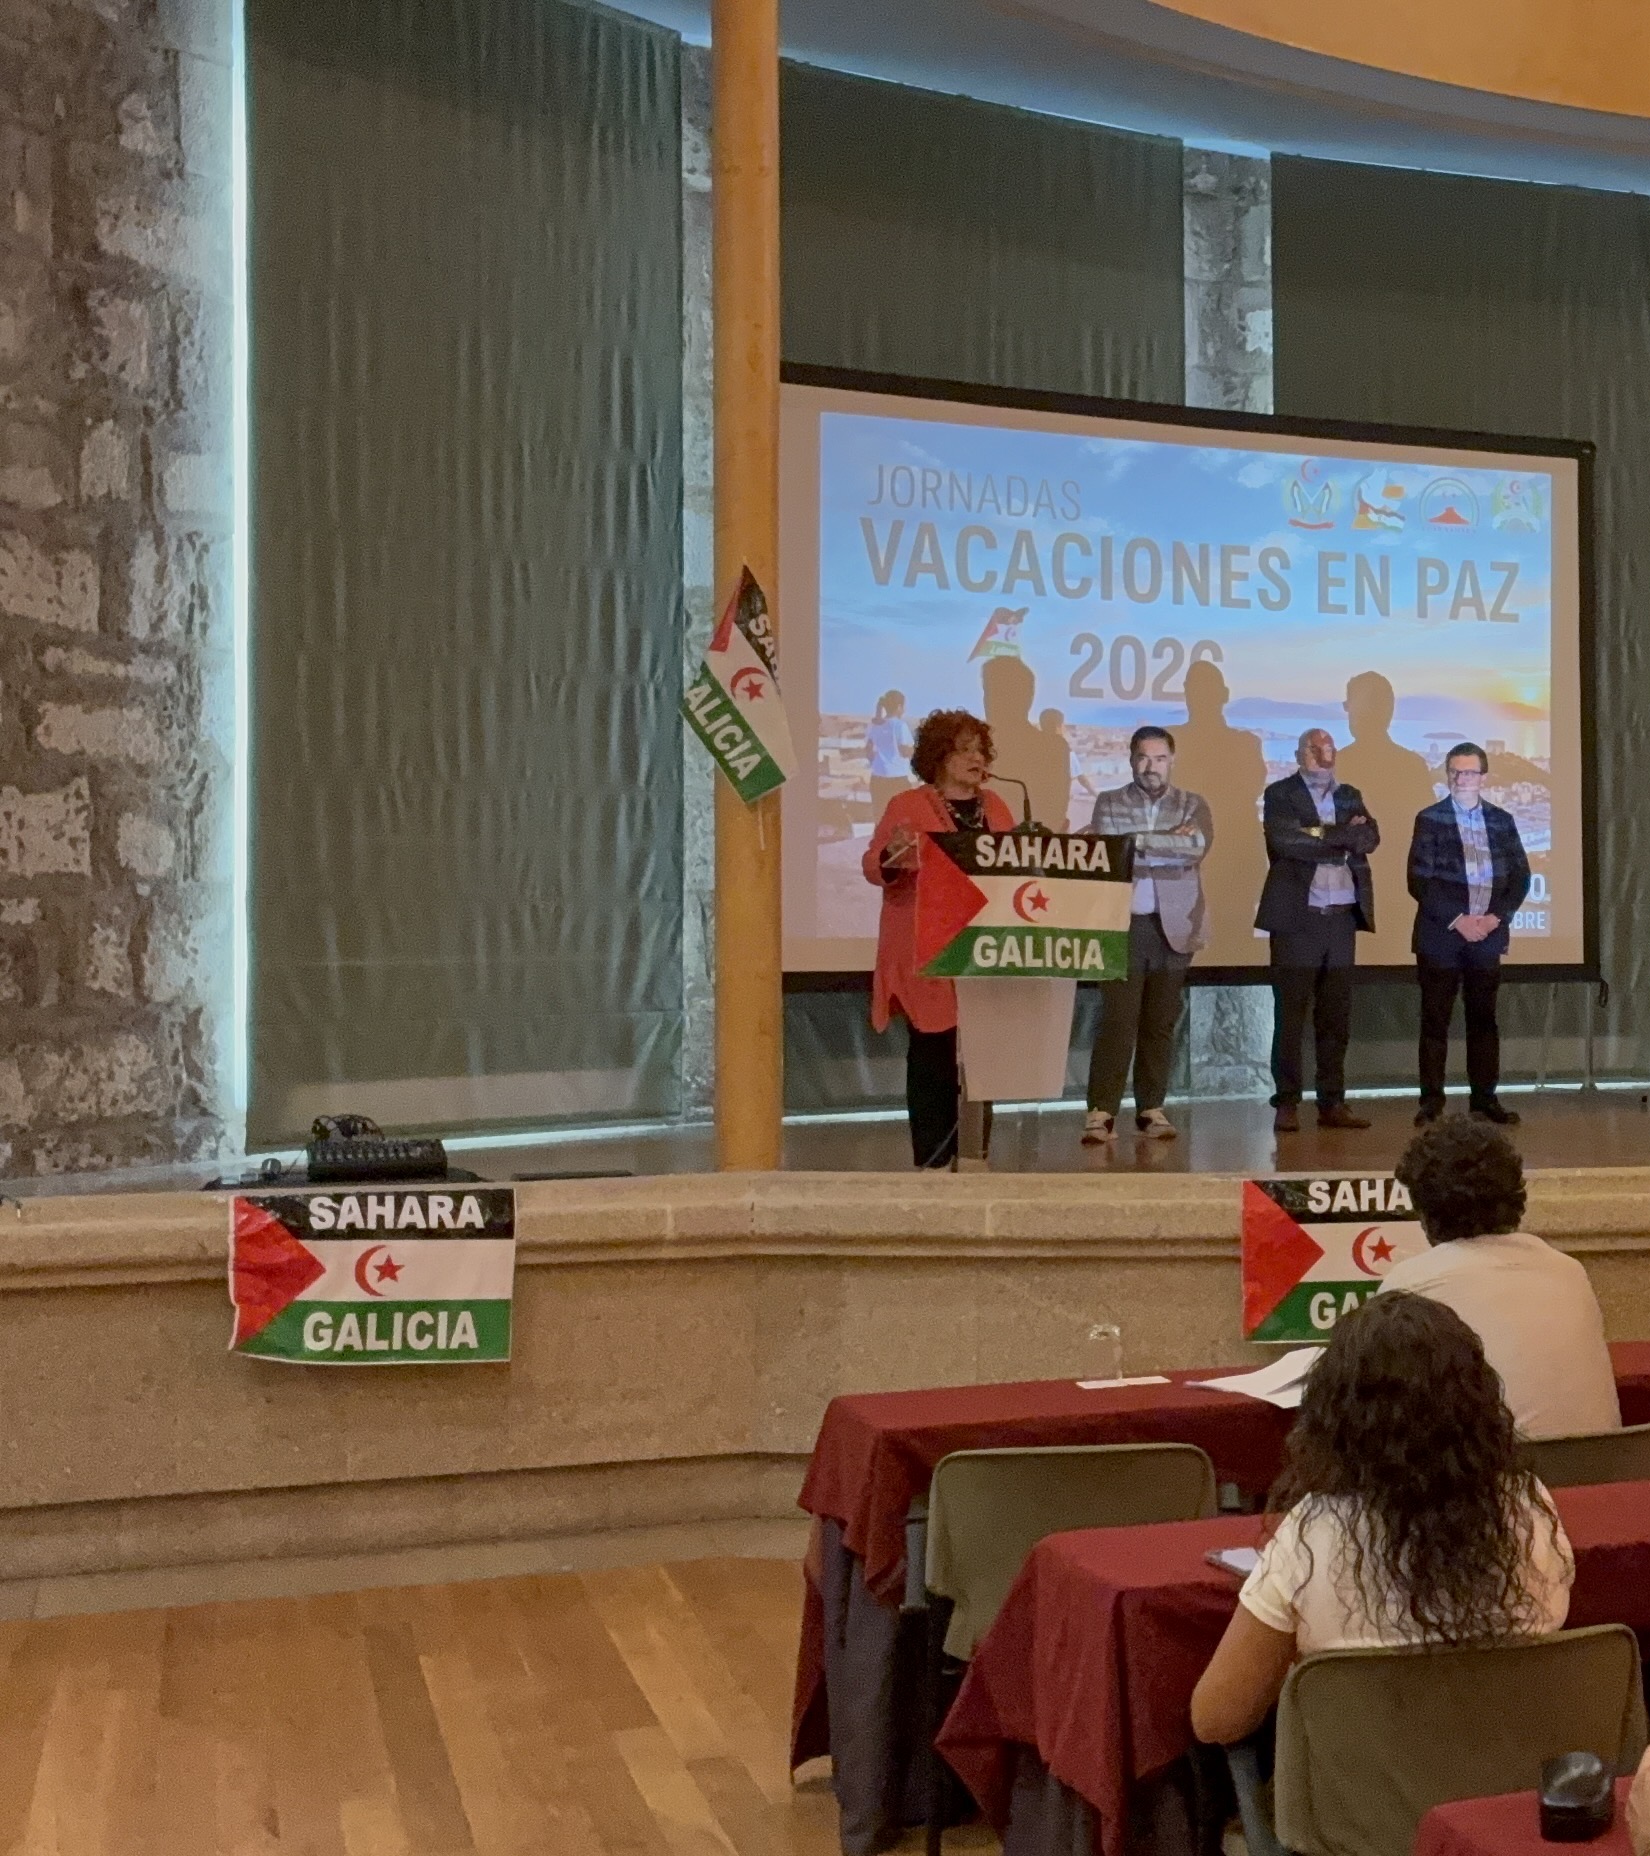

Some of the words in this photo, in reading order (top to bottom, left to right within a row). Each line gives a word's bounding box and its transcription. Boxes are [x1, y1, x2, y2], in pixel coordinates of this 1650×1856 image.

[868, 463, 1083, 523] JORNADAS
[859, 517, 1292, 611] VACACIONES
[1317, 552, 1391, 617] EN
[1416, 559, 1521, 624] PAZ
[685, 683, 762, 780] ALICIA
[975, 834, 1111, 873] SAHARA
[973, 935, 1105, 971] GALICIA
[308, 1195, 485, 1230] SAHARA
[1307, 1179, 1413, 1214] SAHA
[303, 1311, 479, 1351] GALICIA
